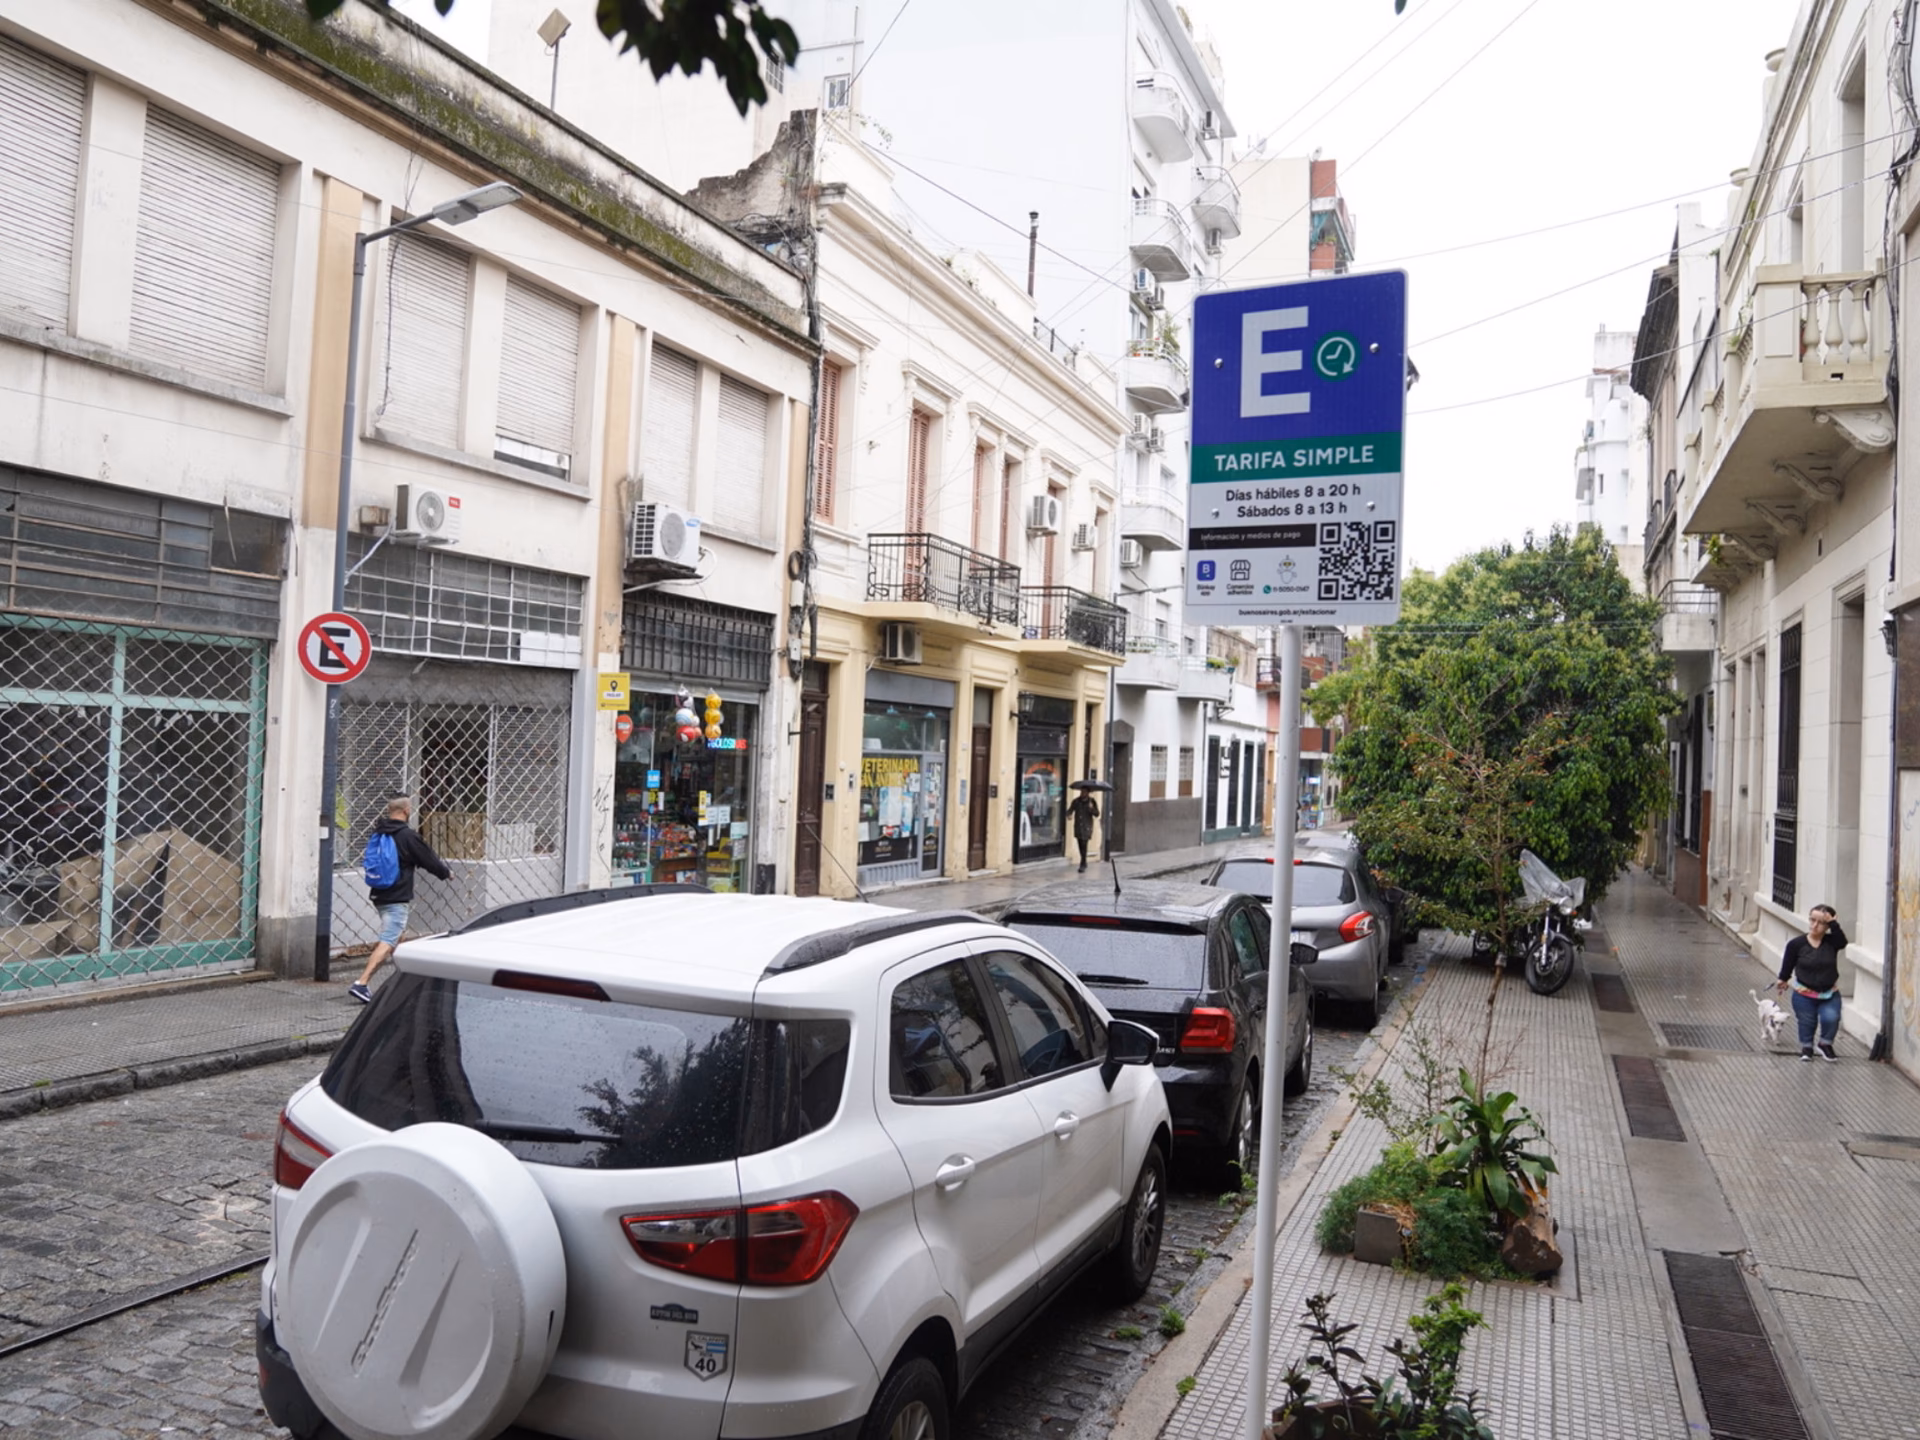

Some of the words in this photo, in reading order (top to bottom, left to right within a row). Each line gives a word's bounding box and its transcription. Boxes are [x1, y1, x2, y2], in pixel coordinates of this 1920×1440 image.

[1240, 305, 1311, 418] E
[1214, 451, 1286, 472] TARIFA
[1293, 445, 1374, 467] SIMPLE
[1226, 489, 1252, 502] Días
[1255, 486, 1300, 501] hábiles
[1304, 485, 1314, 498] 8
[1317, 488, 1325, 497] a
[1329, 483, 1349, 497] 20
[1352, 483, 1361, 496] h
[1237, 504, 1290, 518] Sábados
[1294, 503, 1304, 515] 8
[1307, 505, 1315, 515] a
[1320, 502, 1334, 514] 13
[1338, 501, 1347, 514] h
[1200, 533, 1240, 541] Información
[1247, 531, 1271, 539] medios
[1273, 531, 1281, 539] de
[1283, 531, 1301, 540] pago
[319, 627, 351, 669] E
[695, 1357, 717, 1373] 40
